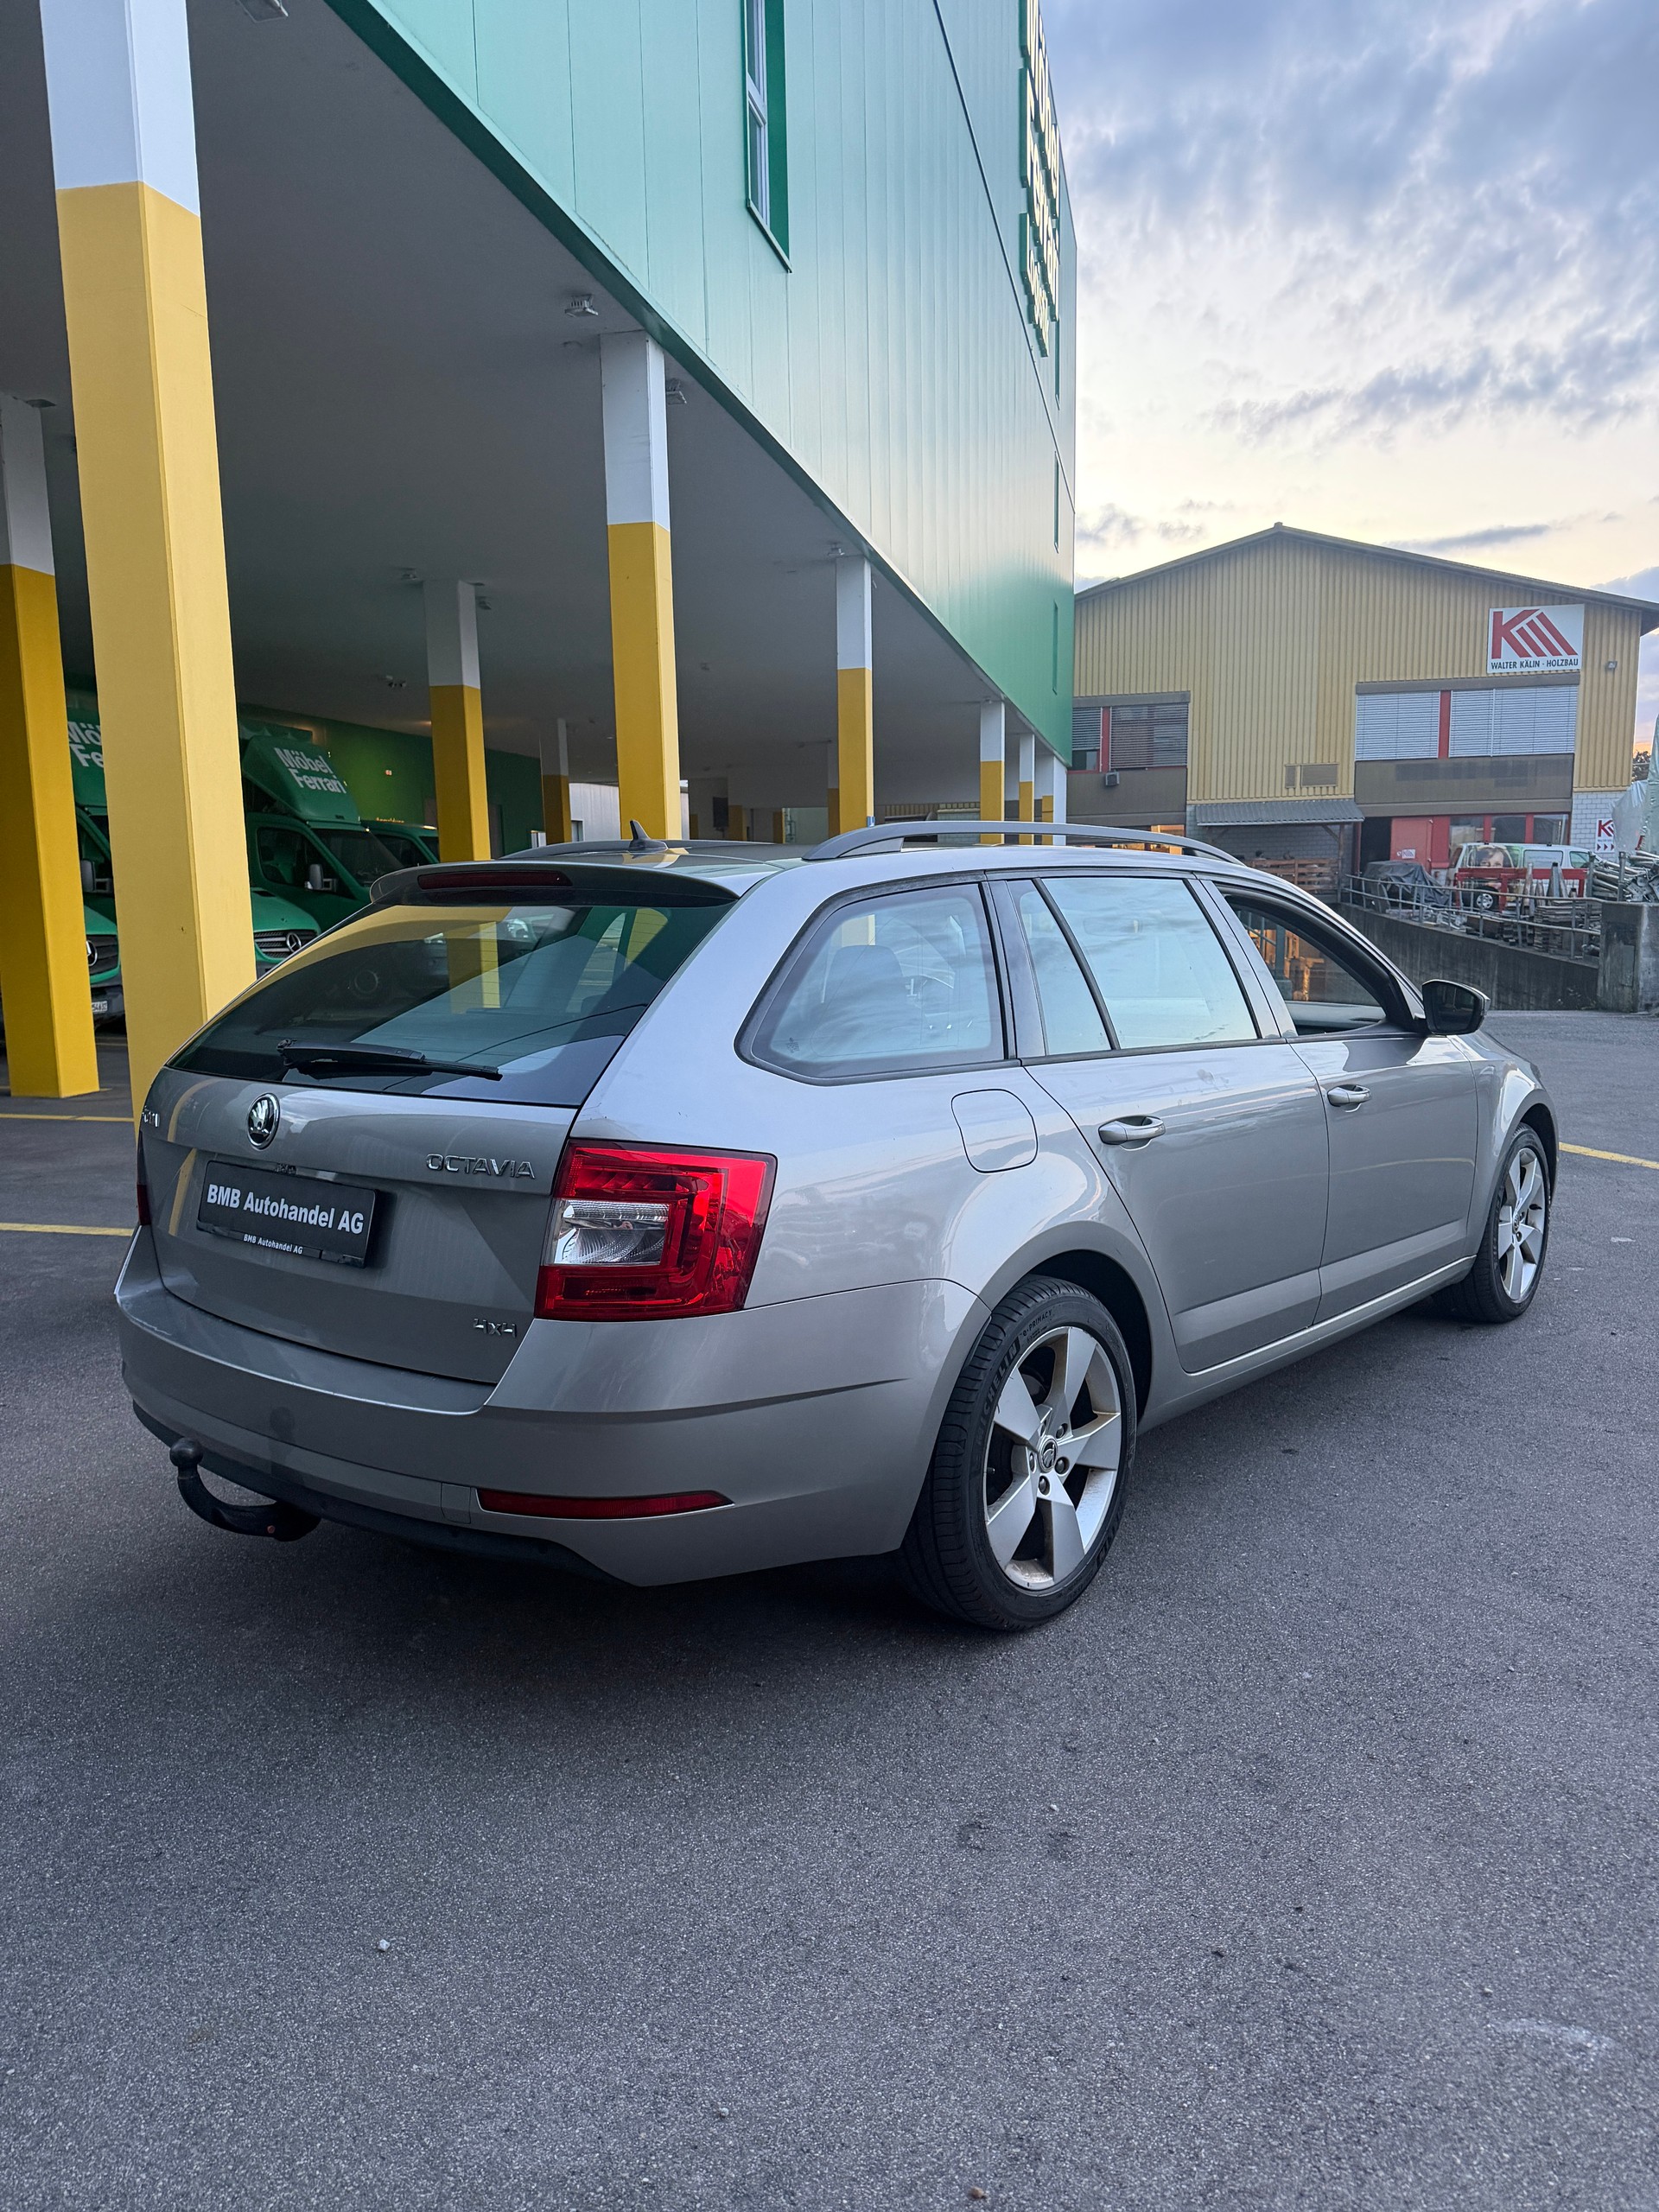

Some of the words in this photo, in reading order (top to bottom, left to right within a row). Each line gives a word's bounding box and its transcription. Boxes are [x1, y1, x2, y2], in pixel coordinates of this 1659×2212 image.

[1026, 68, 1059, 321] Ferrari
[1026, 213, 1049, 357] Logistik
[1491, 661, 1517, 670] WALTER
[1519, 659, 1541, 669] KÄLIN
[1546, 658, 1579, 667] HOLZBAU
[274, 747, 334, 774] Möbel
[288, 768, 346, 794] Ferrari
[426, 1154, 536, 1179] OCTAVIA
[207, 1184, 241, 1209] BMB
[243, 1192, 335, 1229] Autohandel
[337, 1210, 364, 1235] AG
[243, 1234, 257, 1244] BMB
[257, 1236, 292, 1253] Autohandel
[293, 1246, 303, 1255] AG
